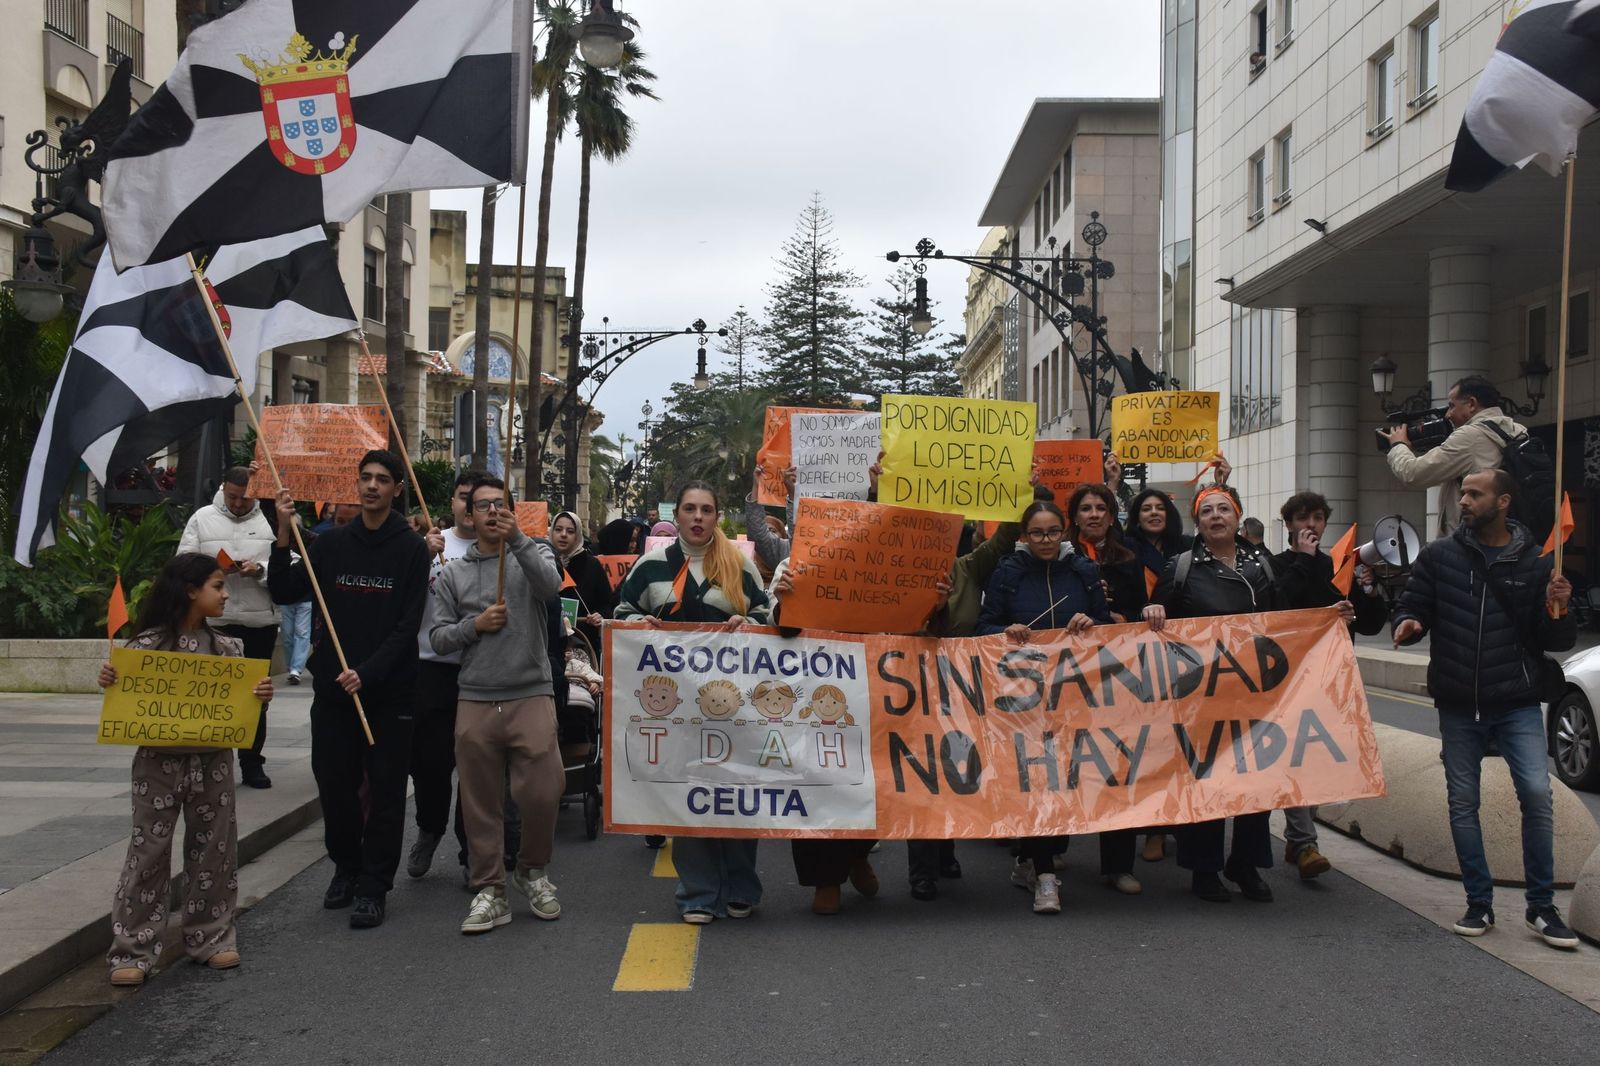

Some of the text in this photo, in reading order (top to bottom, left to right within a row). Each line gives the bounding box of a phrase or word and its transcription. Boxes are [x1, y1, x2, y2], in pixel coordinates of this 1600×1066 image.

[1120, 392, 1212, 411] PRIVATIZAR
[799, 416, 818, 431] NO
[822, 415, 857, 431] SOMOS
[885, 402, 1031, 441] POR DIGNIDAD,
[1152, 411, 1172, 426] ES
[799, 435, 834, 449] SOMOS
[1116, 428, 1210, 442] ABANDONAR
[798, 453, 869, 466] LUCHAN POR
[914, 441, 1016, 472] LOPERA
[1122, 441, 1205, 460] LO PÚBLICO
[799, 470, 864, 485] DERECHOS
[895, 474, 1018, 509] DIMISIÓN
[891, 515, 952, 534] SANIDAD
[799, 526, 816, 538] ES
[878, 532, 904, 547] CON
[911, 537, 953, 553] VIDAS
[865, 551, 884, 565] NO
[890, 556, 905, 568] SE
[912, 557, 949, 573] CALLA
[336, 574, 394, 589] MCKENZIE
[834, 567, 849, 582] LA
[854, 571, 888, 585] MALA
[815, 584, 842, 601] DEL
[140, 655, 246, 679] PROMESAS
[636, 644, 856, 680] ASOCIACIÓN
[877, 634, 1290, 717] SIN SANIDAD
[121, 675, 232, 700] DESDE 2018
[135, 699, 235, 721] SOLUCIONES
[888, 708, 1348, 796] NO HAY VIDA
[686, 787, 809, 816] CEUTA
